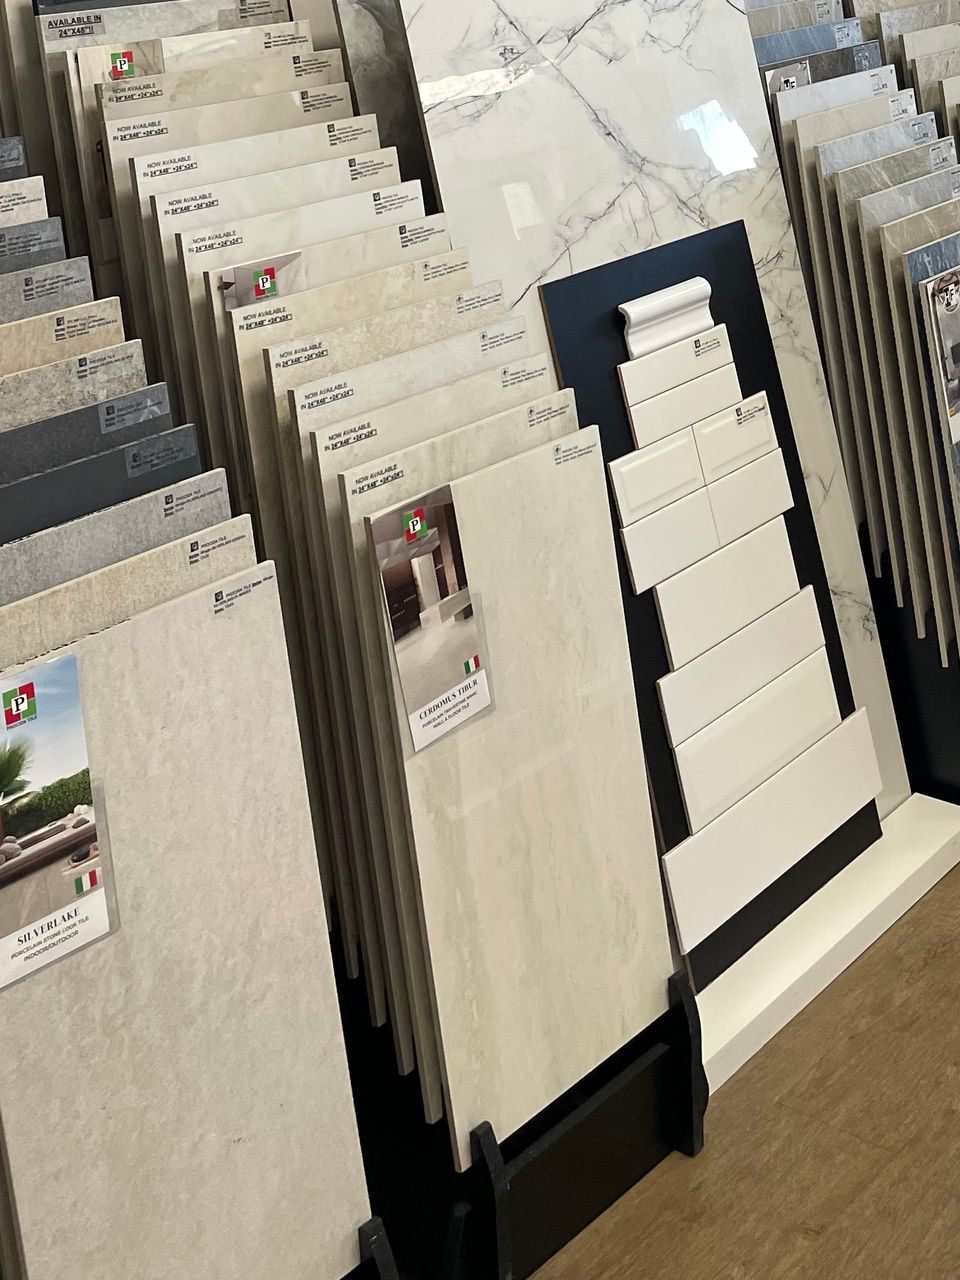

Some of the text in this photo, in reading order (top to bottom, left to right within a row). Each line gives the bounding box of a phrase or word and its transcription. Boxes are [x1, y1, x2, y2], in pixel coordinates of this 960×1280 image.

[48, 14, 102, 29] AVAILABLE IN
[132, 120, 161, 129] AVAILABLE
[162, 155, 191, 165] AVAILABLE
[183, 193, 212, 203] AVAILABLE
[193, 230, 237, 244] NOW AVAILABLE
[261, 277, 268, 288] P
[243, 306, 287, 321] NOW AVAILABLE
[294, 342, 322, 354] AVAILABLE
[304, 382, 347, 400] NOW AVAILABLE
[328, 422, 371, 441] NOW AVAILABLE
[355, 464, 397, 484] NOW AVAILABLE
[411, 520, 418, 531] P
[13, 697, 25, 712] P
[419, 679, 478, 720] CERDOMUS TIBUR
[461, 703, 470, 711] TILE
[422, 712, 443, 728] PORCELAIN
[17, 907, 80, 945] SILVERLAKE
[11, 916, 89, 959] PORCELAIN STONE LOOK TILE
[24, 930, 79, 961] INDOOR/OUTDOOR
